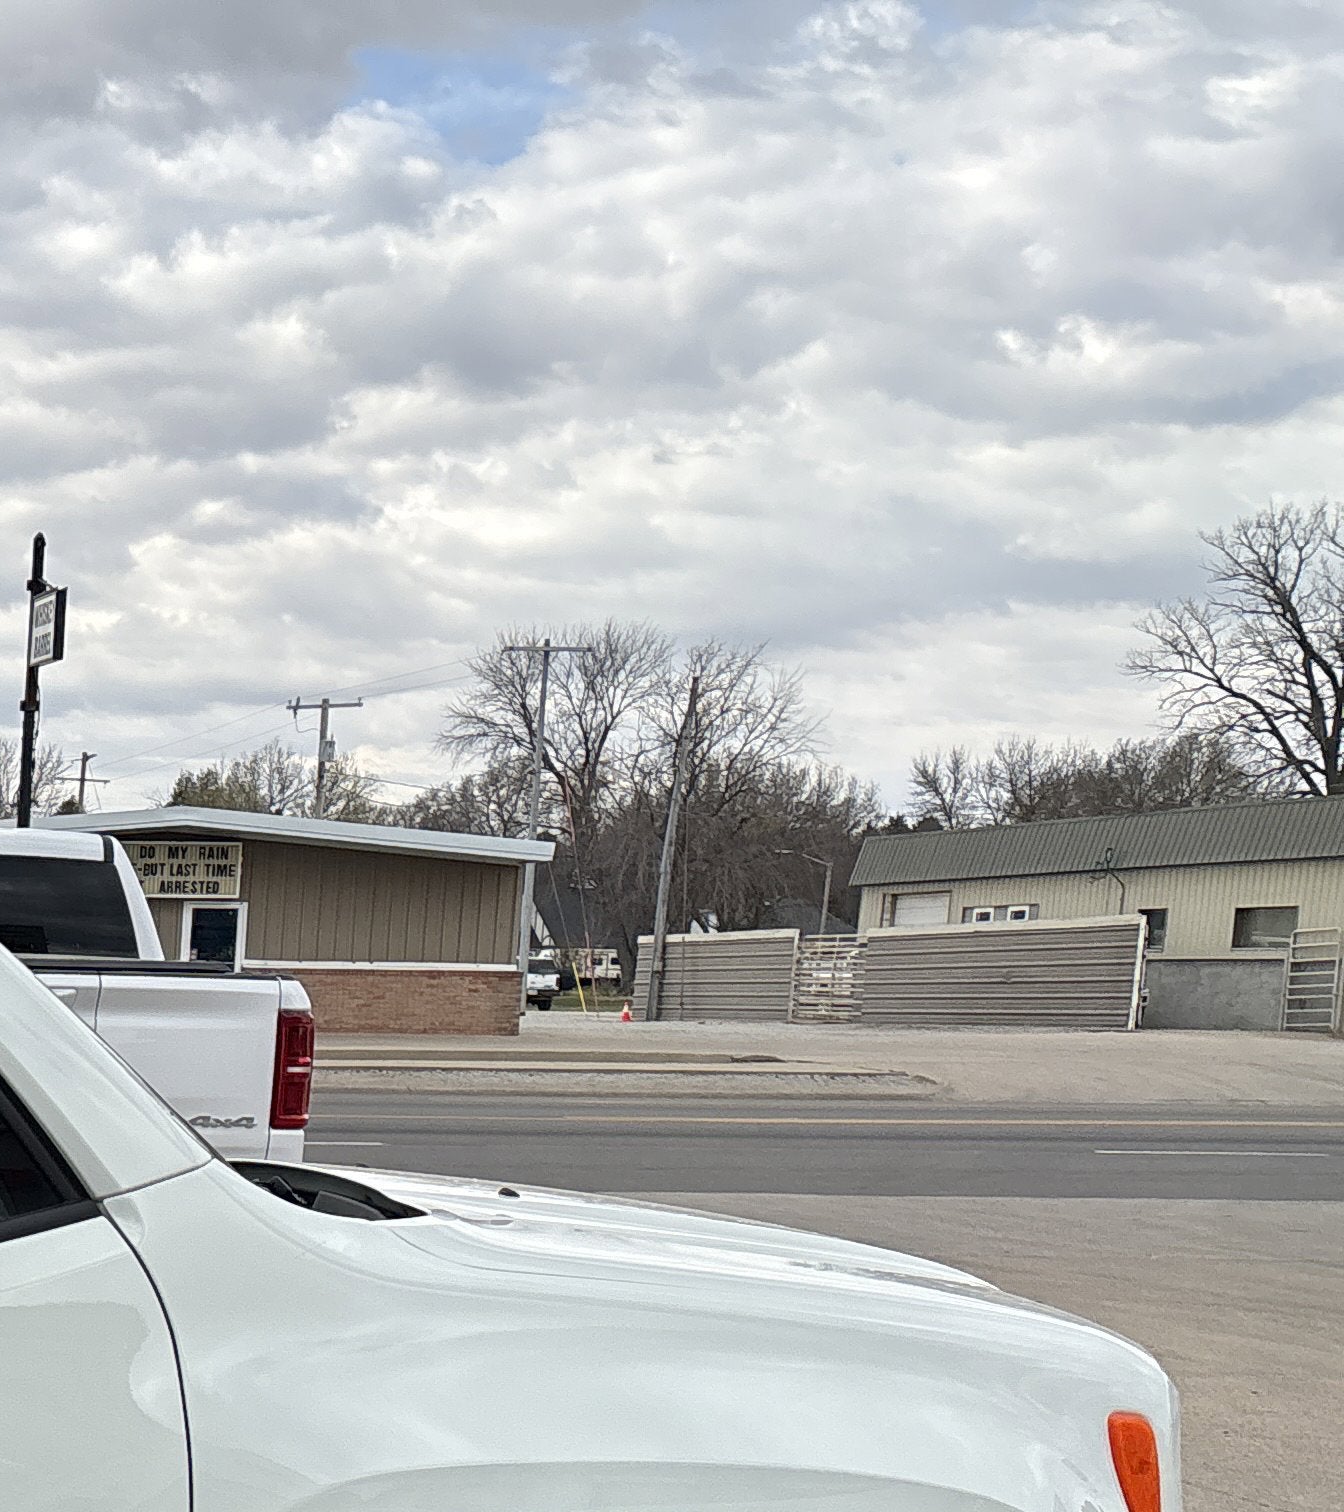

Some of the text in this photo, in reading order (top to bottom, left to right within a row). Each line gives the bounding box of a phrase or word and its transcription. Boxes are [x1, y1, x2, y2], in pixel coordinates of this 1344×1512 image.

[139, 845, 230, 860] DO MY RAIN
[169, 863, 198, 877] LAST
[205, 863, 237, 878] TIME
[159, 880, 220, 894] ARRESTED
